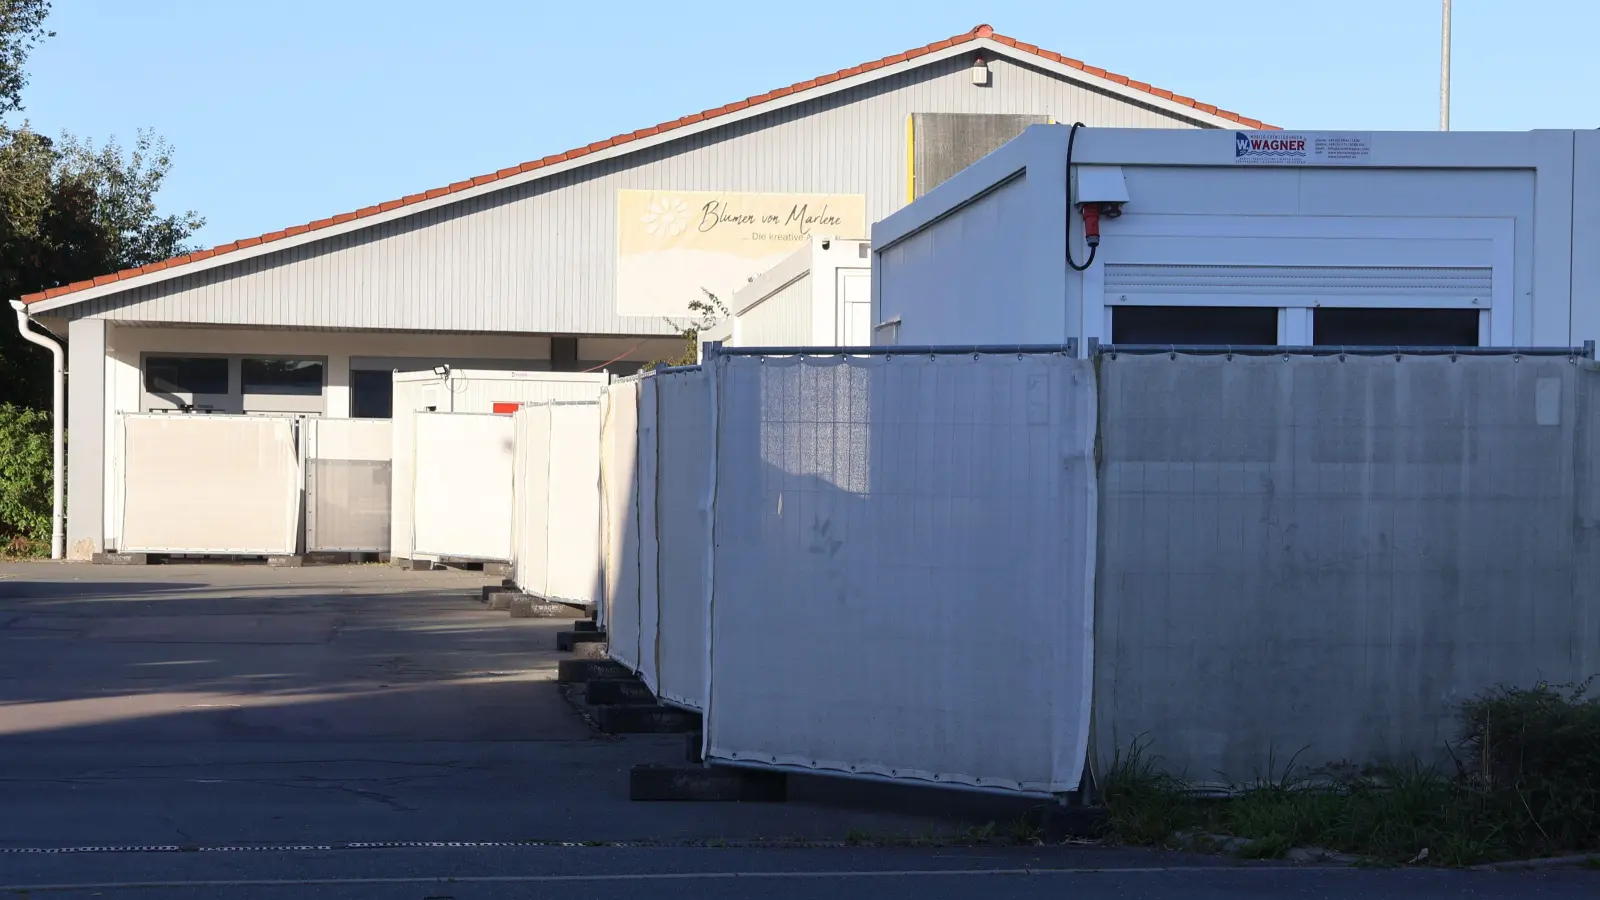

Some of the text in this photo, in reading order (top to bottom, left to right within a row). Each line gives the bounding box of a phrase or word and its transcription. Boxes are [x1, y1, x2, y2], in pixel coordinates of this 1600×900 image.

[1250, 139, 1305, 151] WAGNER
[698, 200, 842, 235] Blumen von Marlene
[752, 232, 766, 241] Die
[769, 232, 804, 241] kreative
